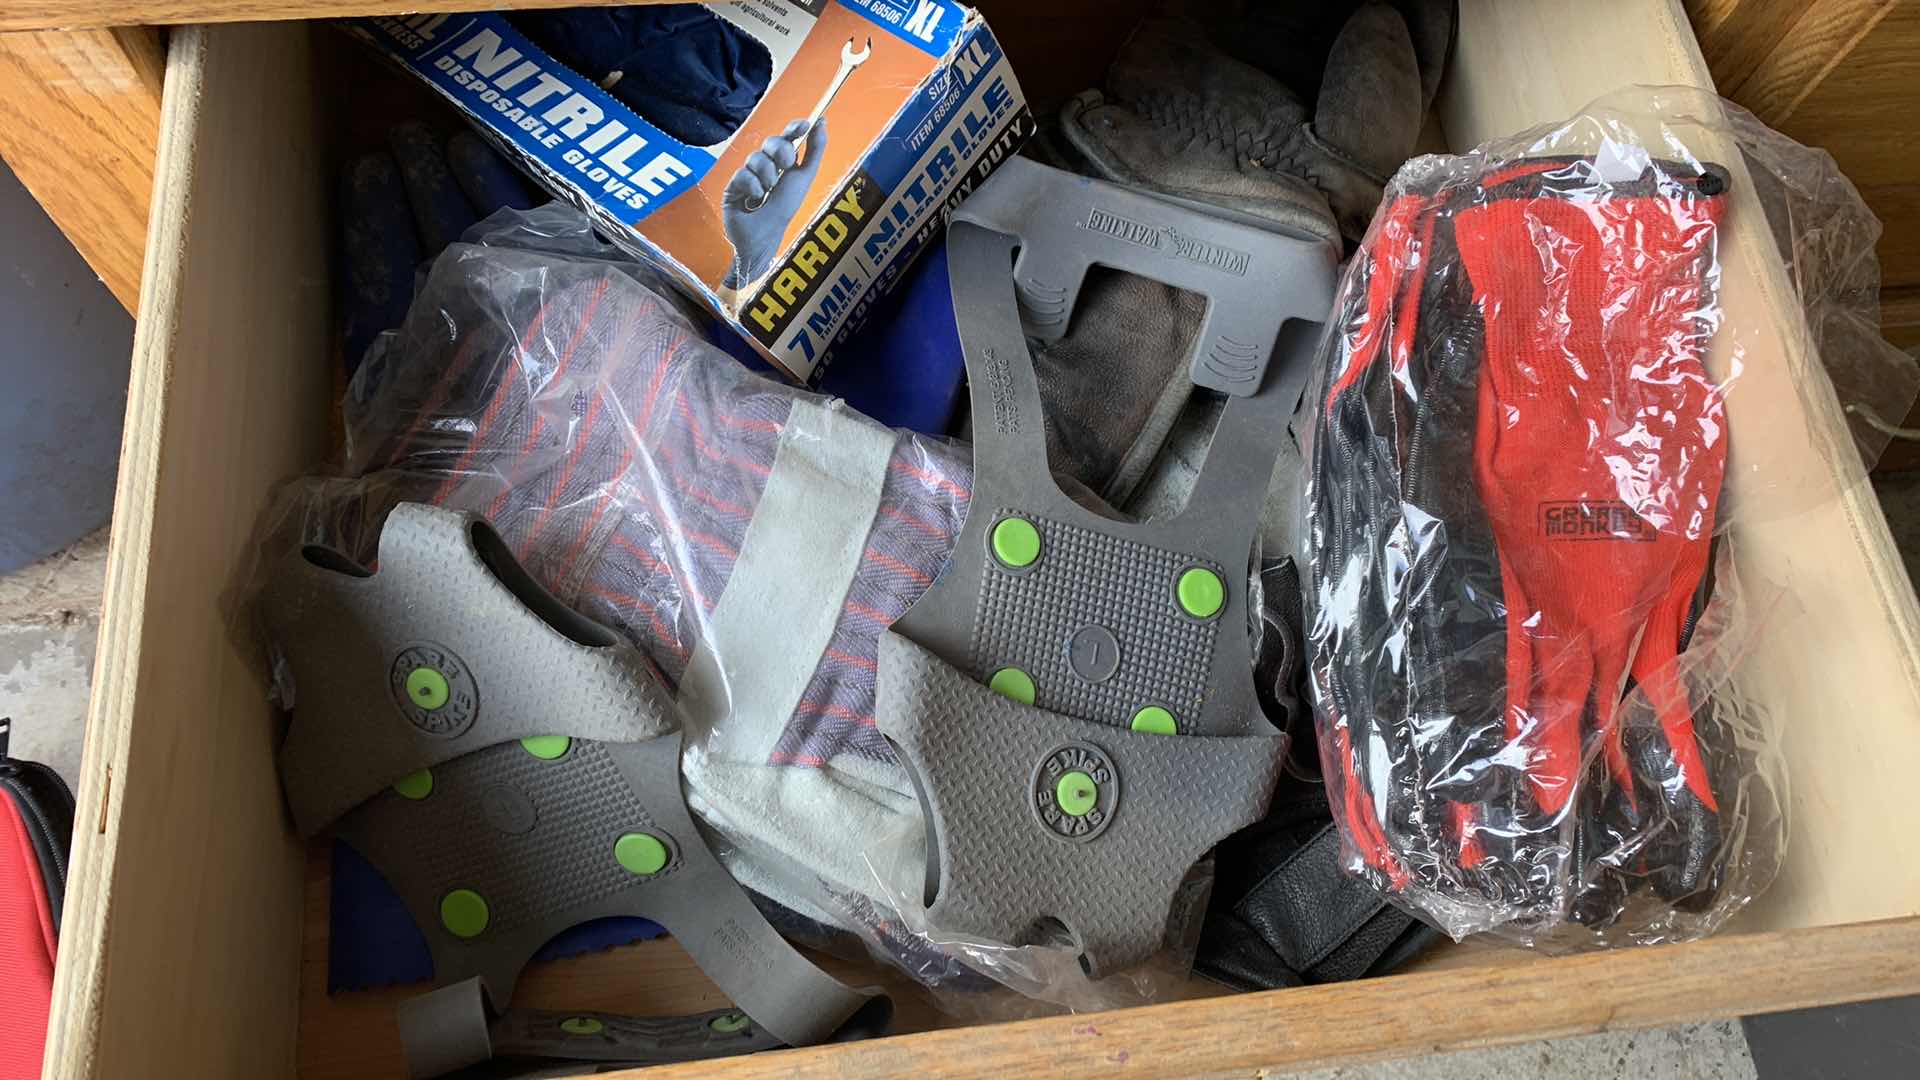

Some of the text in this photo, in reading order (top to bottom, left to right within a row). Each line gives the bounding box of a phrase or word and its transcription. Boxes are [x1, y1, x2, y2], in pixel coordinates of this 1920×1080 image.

[740, 3, 791, 36] agricultural work
[870, 1, 903, 24] 68506
[903, 0, 945, 43] XL
[955, 38, 991, 86] XL
[433, 55, 650, 210] DISPOSABLE GLOVES
[452, 27, 693, 197] NITRILE
[910, 87, 961, 151] ITEM 68506
[873, 163, 959, 267] DISPOSABLE
[962, 95, 1014, 161] GLOVES
[786, 76, 1011, 363] 7 MIL NITRILE
[836, 264, 898, 346] GLOVES
[977, 118, 1024, 179] DUTY
[1090, 210, 1161, 249] WALKING
[750, 186, 865, 332] HARDY
[1044, 748, 1110, 785] SPIKE
[1037, 789, 1103, 835] SPARE
